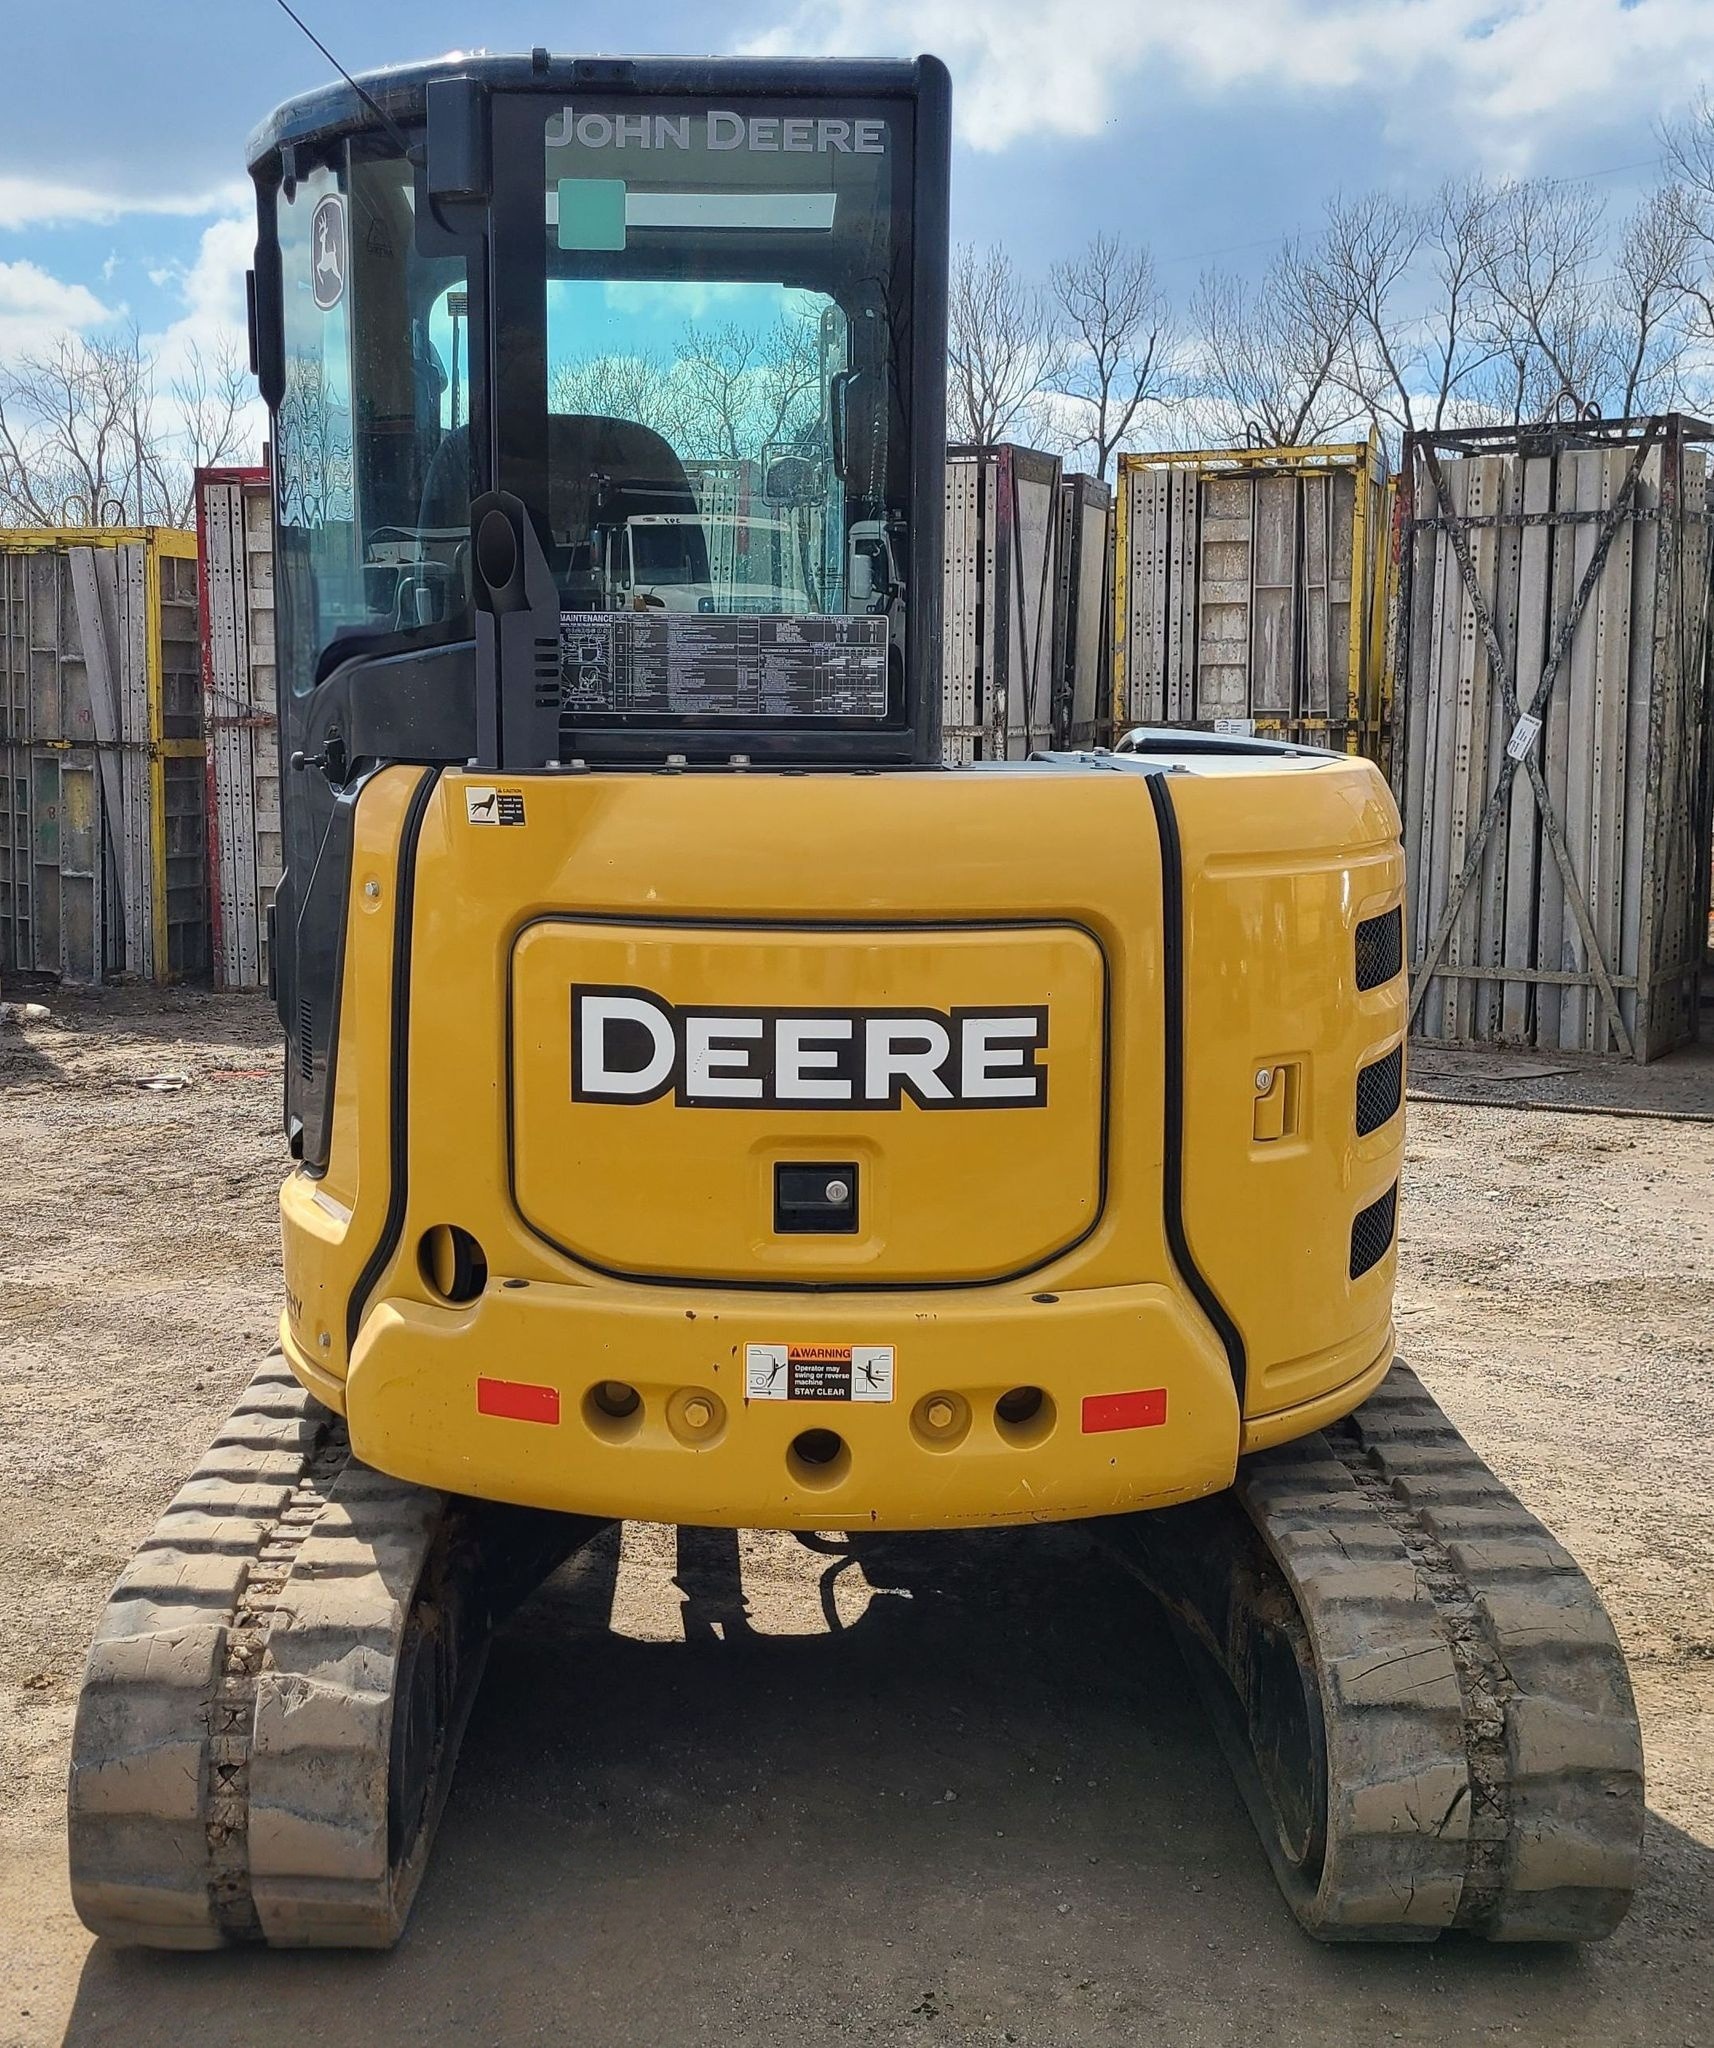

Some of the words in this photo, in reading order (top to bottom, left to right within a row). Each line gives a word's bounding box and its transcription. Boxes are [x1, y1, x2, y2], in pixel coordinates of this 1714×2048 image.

[545, 107, 690, 149] JOHN
[707, 111, 885, 153] DEERE
[580, 995, 1038, 1099] DEERE
[800, 1348, 851, 1358] WARNING
[795, 1364, 825, 1372] Operator
[794, 1387, 815, 1395] STAY
[816, 1388, 845, 1396] CLEAR
